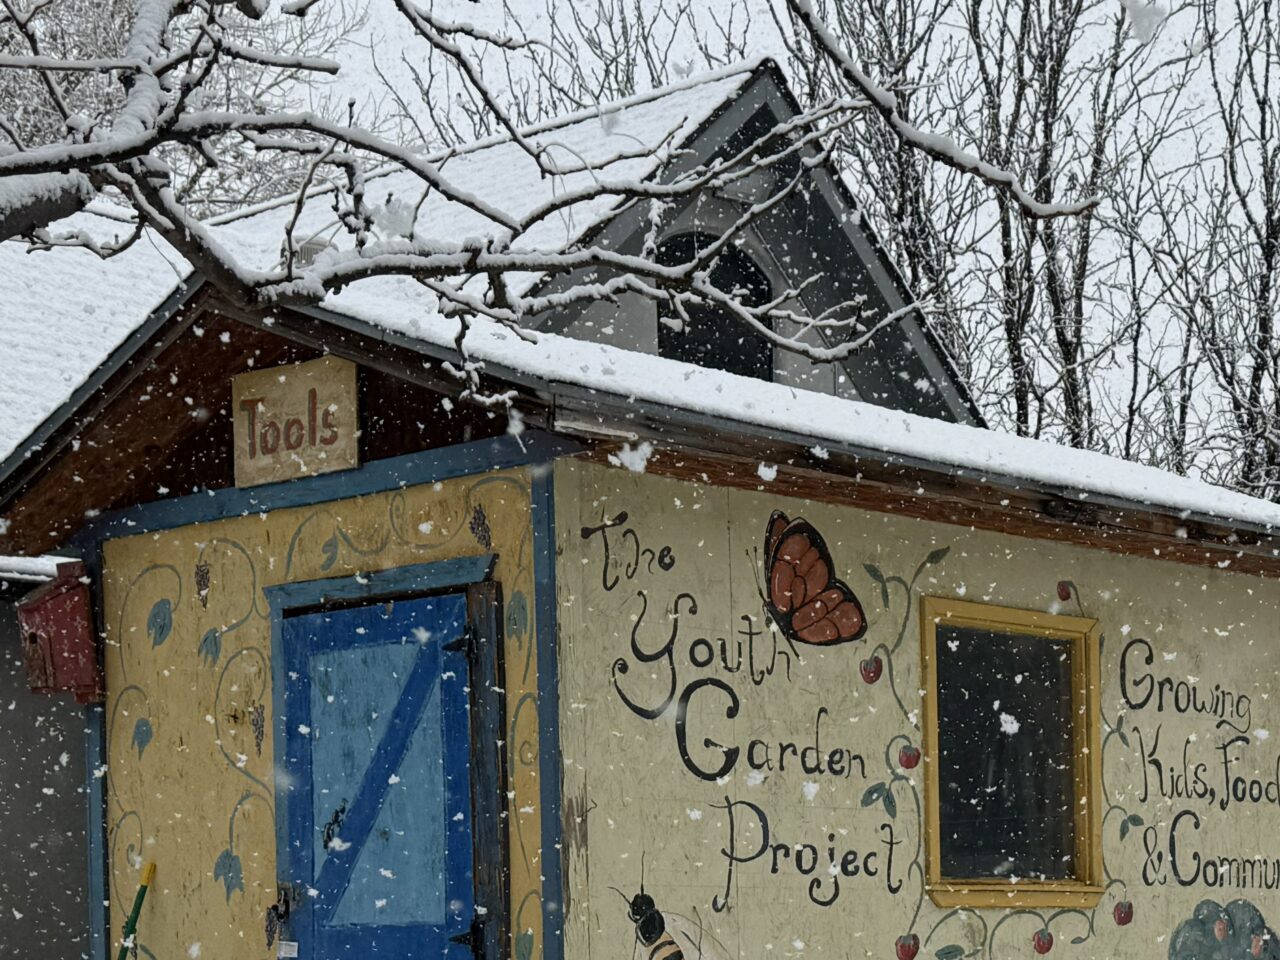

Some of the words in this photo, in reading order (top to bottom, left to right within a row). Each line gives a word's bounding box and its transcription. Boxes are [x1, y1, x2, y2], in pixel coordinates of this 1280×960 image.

[239, 387, 339, 460] Tools
[612, 590, 791, 720] Youth
[1119, 638, 1252, 733] Growing
[675, 678, 867, 782] Garden
[708, 795, 902, 913] Project
